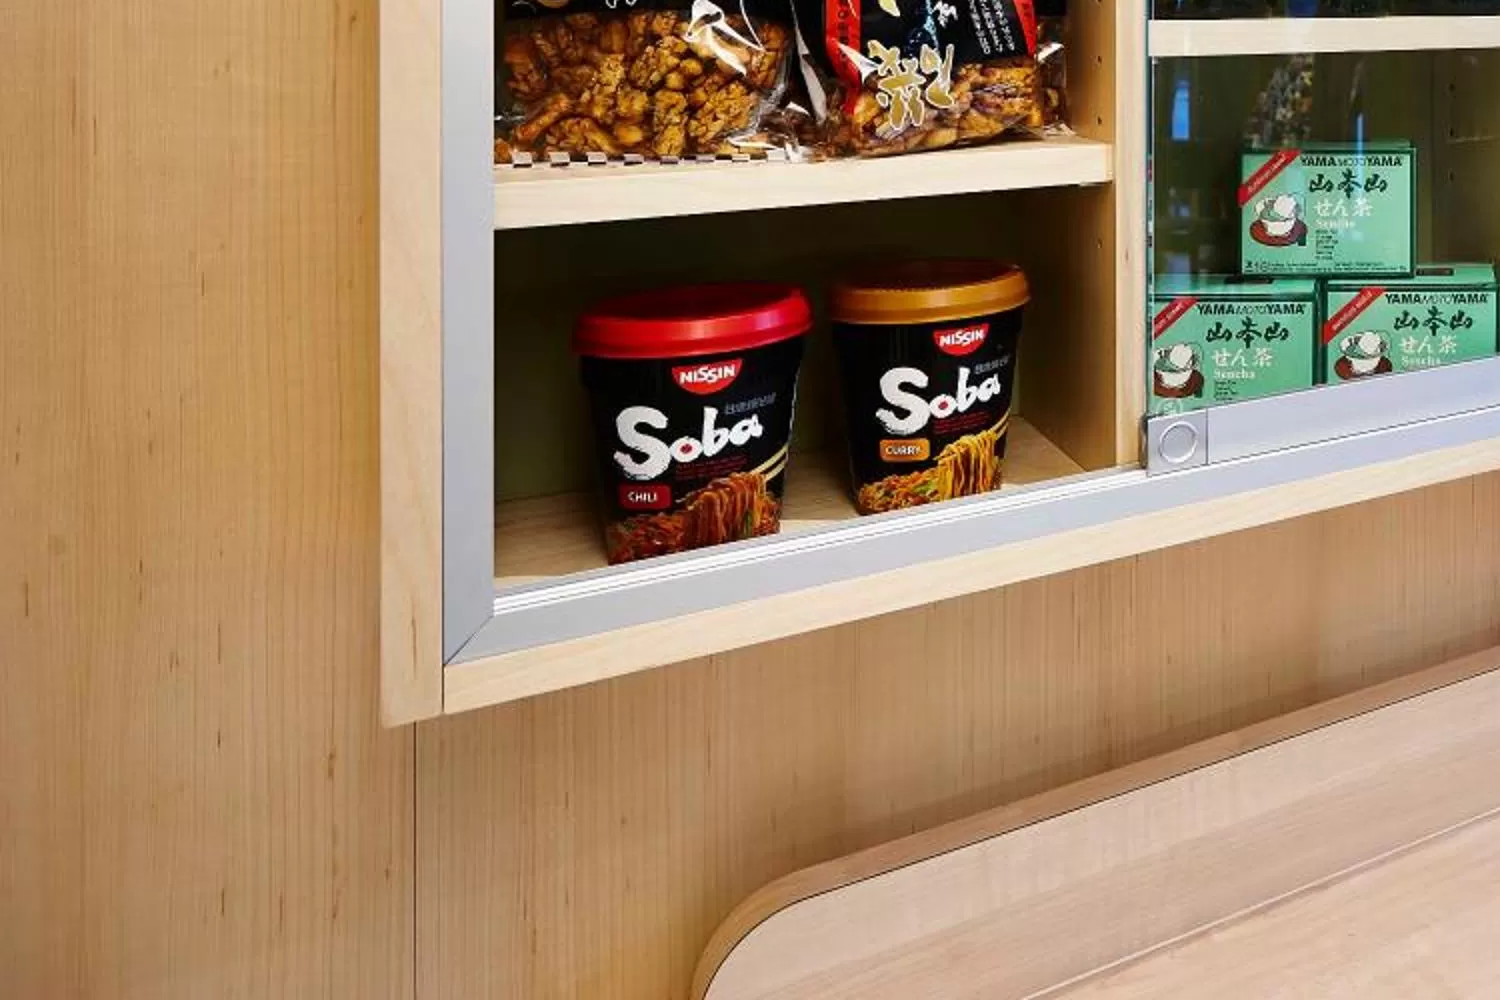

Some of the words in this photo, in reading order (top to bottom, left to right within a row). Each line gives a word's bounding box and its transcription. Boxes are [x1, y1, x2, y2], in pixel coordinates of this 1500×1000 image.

[1198, 303, 1305, 315] YAMAMOTOYAMA
[939, 328, 986, 347] NISSIN
[679, 364, 736, 385] NISSIN
[1213, 369, 1256, 380] Sencha
[875, 366, 1002, 436] Soba
[613, 405, 764, 481] Soba
[885, 444, 922, 456] CURRY
[628, 490, 658, 503] CHILI
